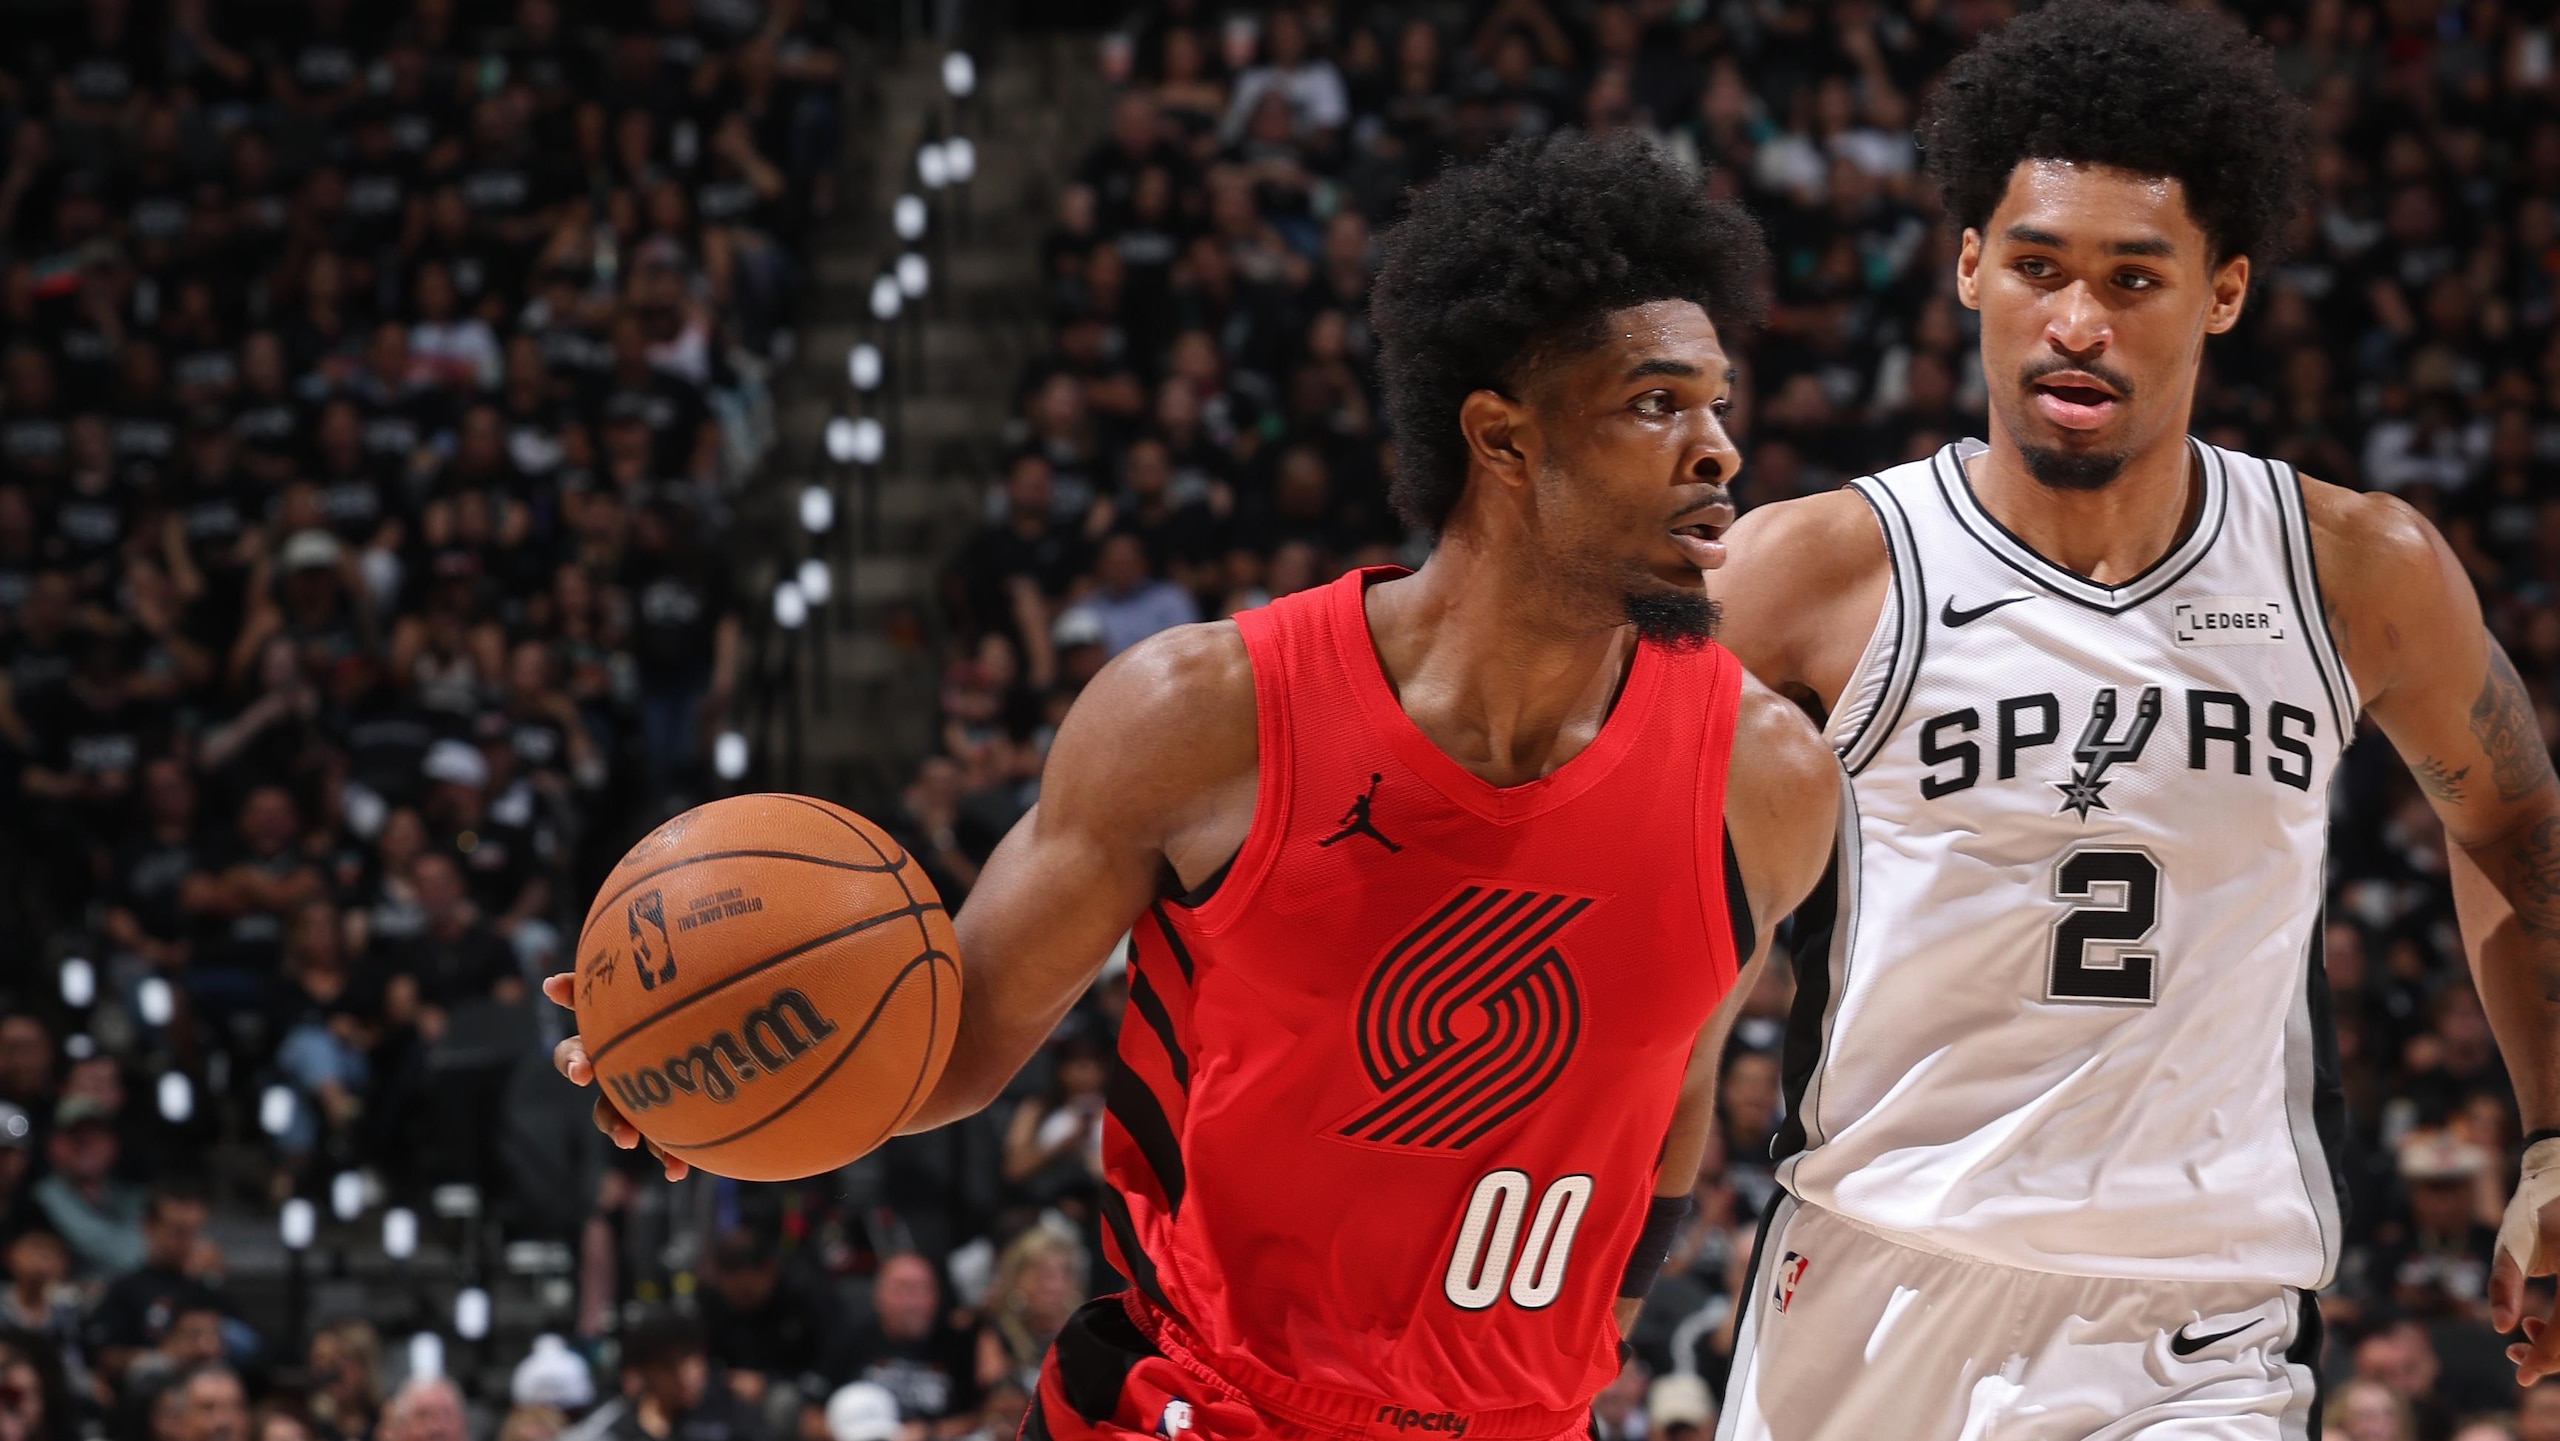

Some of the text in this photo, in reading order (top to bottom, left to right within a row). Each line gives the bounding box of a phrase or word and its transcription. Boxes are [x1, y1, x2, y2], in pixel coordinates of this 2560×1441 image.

[2190, 611, 2271, 632] LEDGER
[1919, 686, 2316, 824] SPURS
[698, 906, 723, 925] GAME
[723, 896, 763, 918] OFFICIAL
[2043, 844, 2164, 1007] 2
[608, 987, 839, 1114] Wilson
[1444, 1167, 1594, 1310] 00
[1376, 1404, 1469, 1439] ripcity
